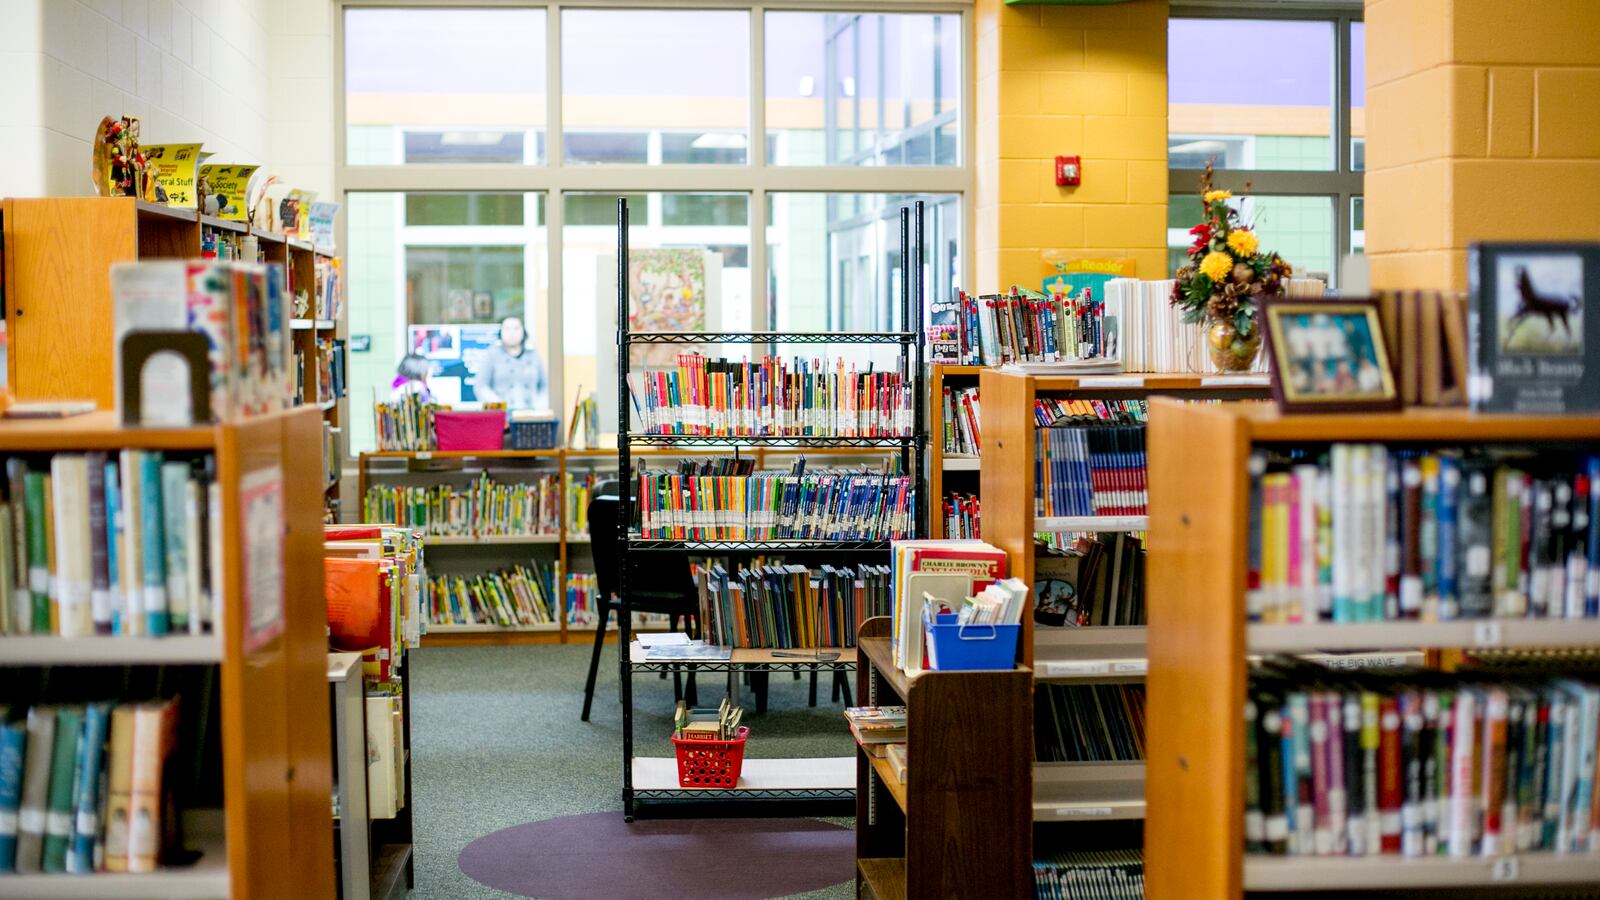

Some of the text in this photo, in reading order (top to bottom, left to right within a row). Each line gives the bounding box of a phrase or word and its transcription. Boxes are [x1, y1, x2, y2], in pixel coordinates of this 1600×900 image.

[176, 177, 193, 186] Stuff
[1081, 259, 1123, 273] Reader
[1326, 657, 1396, 668] THE BIG WAVE
